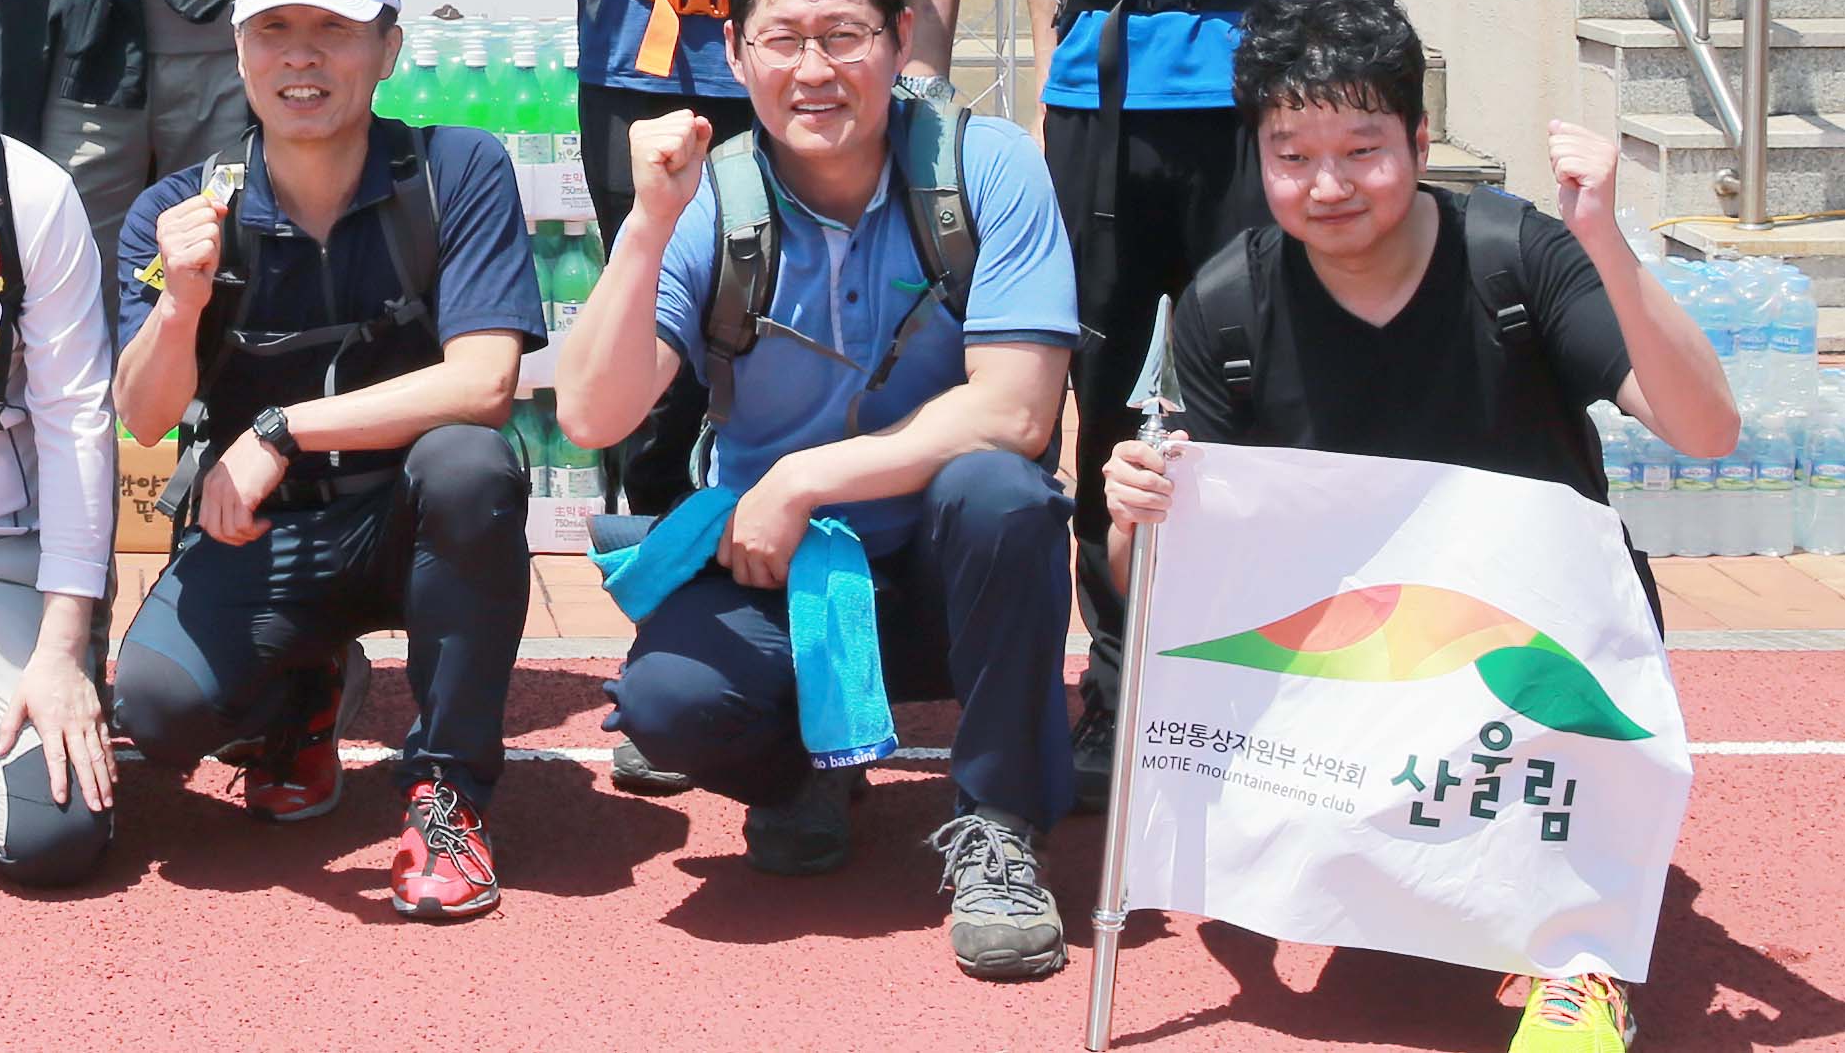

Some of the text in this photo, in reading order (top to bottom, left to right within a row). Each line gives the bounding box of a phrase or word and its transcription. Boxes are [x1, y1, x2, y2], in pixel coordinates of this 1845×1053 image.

[829, 748, 877, 768] bassini
[1141, 754, 1356, 815] MOTIE mountaineering club
[1145, 719, 1367, 790] 산업통상자원부 산악회
[1390, 721, 1577, 842] 산울림
